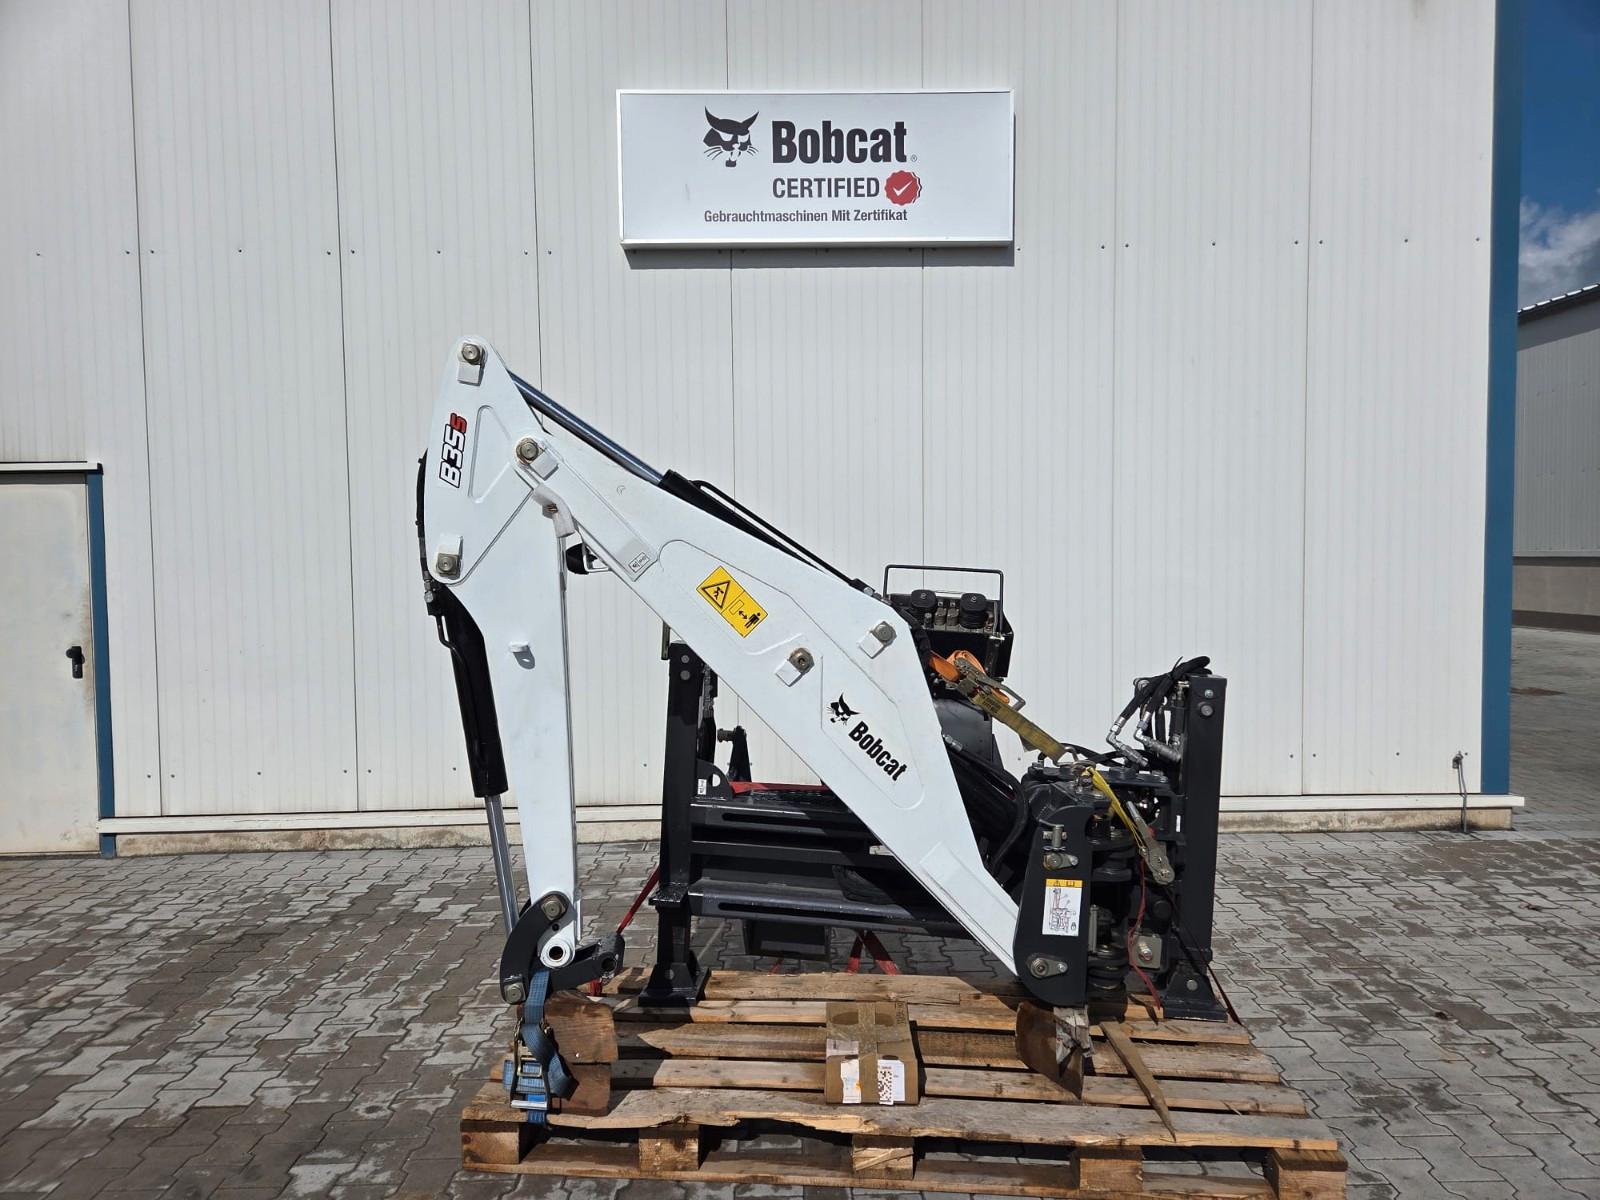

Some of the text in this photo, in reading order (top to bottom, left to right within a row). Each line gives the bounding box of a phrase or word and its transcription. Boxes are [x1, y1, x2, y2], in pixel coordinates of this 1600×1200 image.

[771, 120, 907, 164] Bobcat
[772, 177, 880, 199] CERTIFIED
[704, 209, 908, 222] Gebrauchtmaschinen Mit Zertifikat
[848, 720, 908, 782] Bobcat
